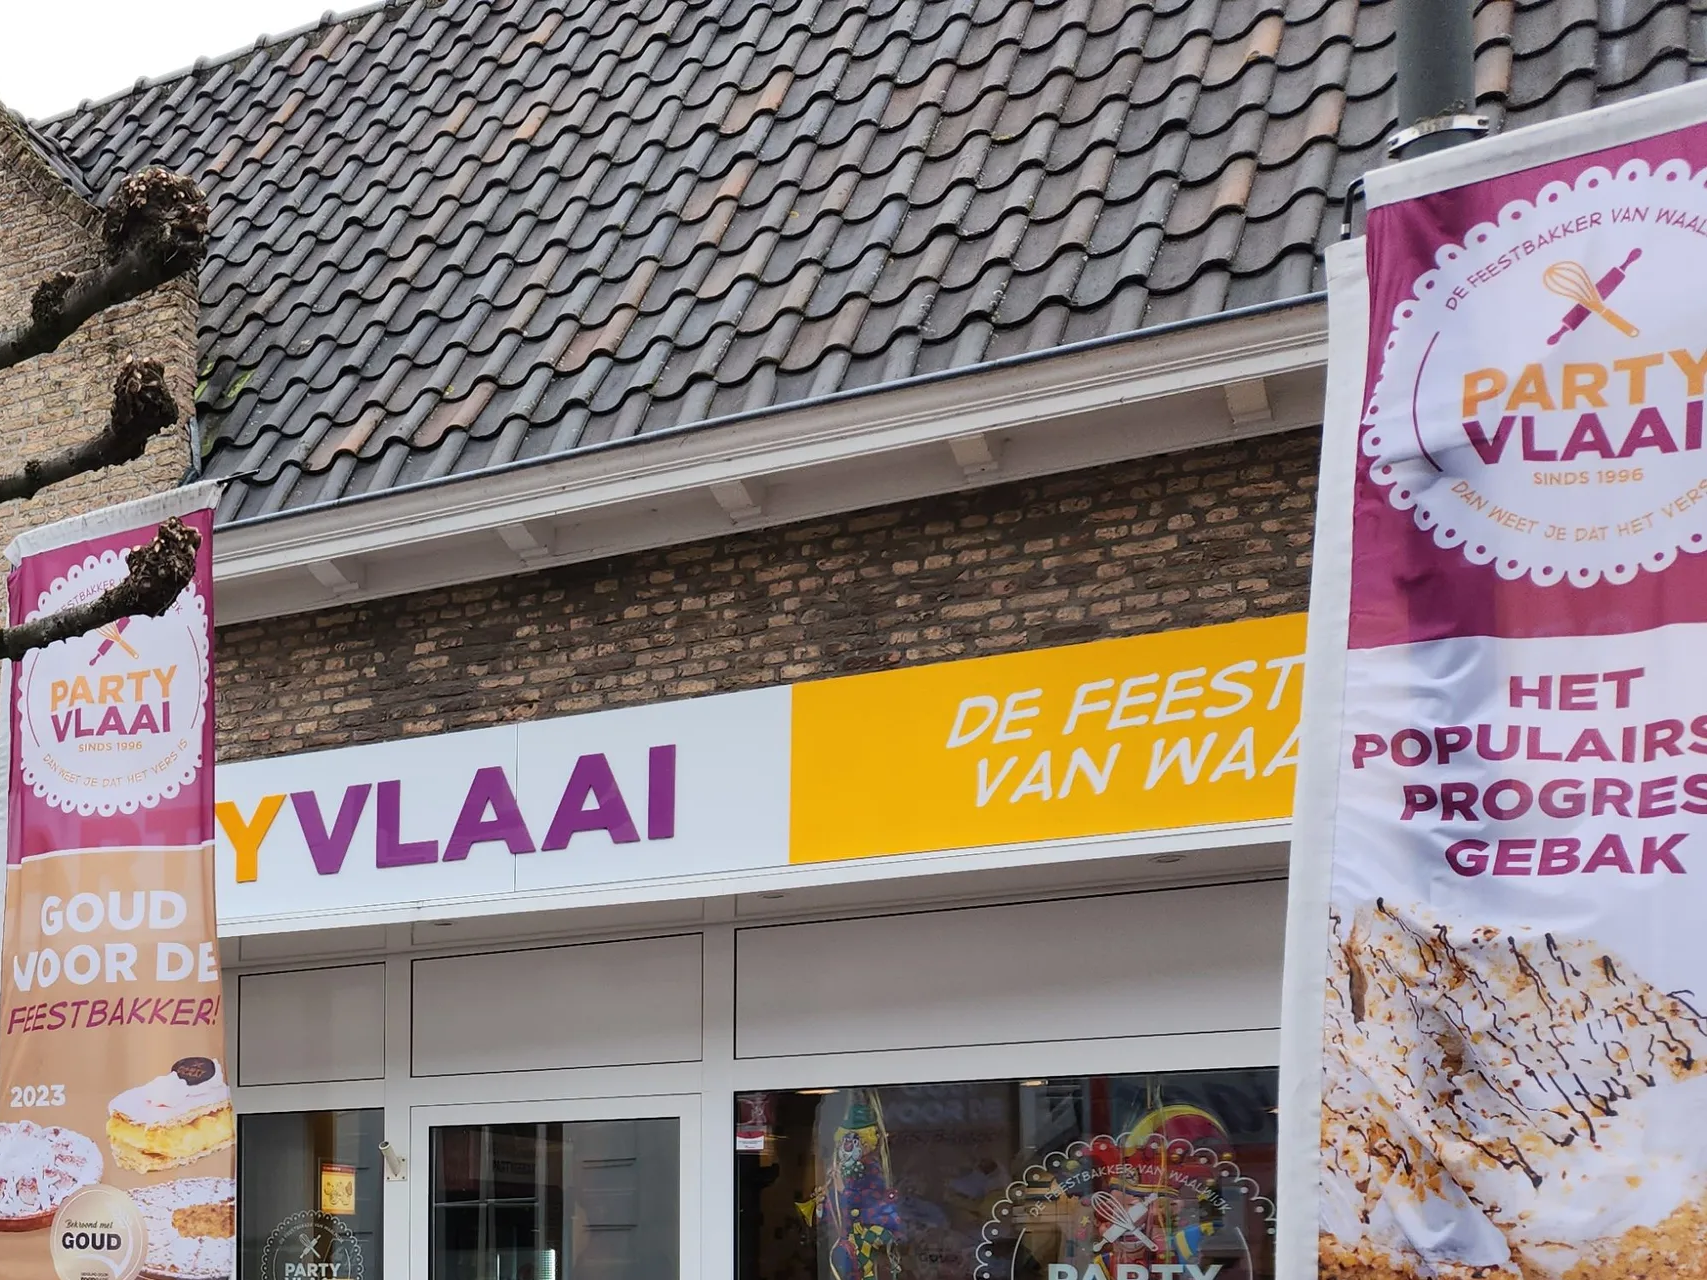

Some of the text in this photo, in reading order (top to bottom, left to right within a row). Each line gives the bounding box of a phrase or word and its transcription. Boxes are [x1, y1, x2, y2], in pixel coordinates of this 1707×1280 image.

[1445, 285, 1470, 311] DE
[1467, 212, 1603, 289] FEESTBAKKER
[1611, 206, 1650, 223] VAN
[1462, 348, 1707, 418] PARTY
[1462, 399, 1705, 465] VLAAI
[1533, 468, 1644, 485] SINDS 1996
[1450, 480, 1489, 511] DAN
[1488, 505, 1540, 534] WEET
[1544, 524, 1567, 541] JE
[1574, 525, 1609, 542] DAT
[1617, 512, 1655, 537] HET
[51, 664, 177, 712] PARTY
[1509, 667, 1646, 711] HET
[51, 700, 170, 743] VLAAI
[946, 688, 1043, 749] DE
[43, 738, 188, 788] DAN WEET JE DAT HET VERS IS
[78, 741, 143, 752] SINDS 1996
[975, 742, 1121, 807] VAN
[1444, 832, 1691, 877] GEBAK
[41, 890, 187, 936] GOUD
[13, 942, 219, 992] VOOR DE
[7, 994, 221, 1035] FEESTBAKKER!
[10, 1084, 66, 1108] 2023
[1029, 1163, 1233, 1218] DE FEESTBAKKER VAN WAALWIJK
[62, 1232, 122, 1251] GOUD
[285, 1263, 341, 1277] PARTY
